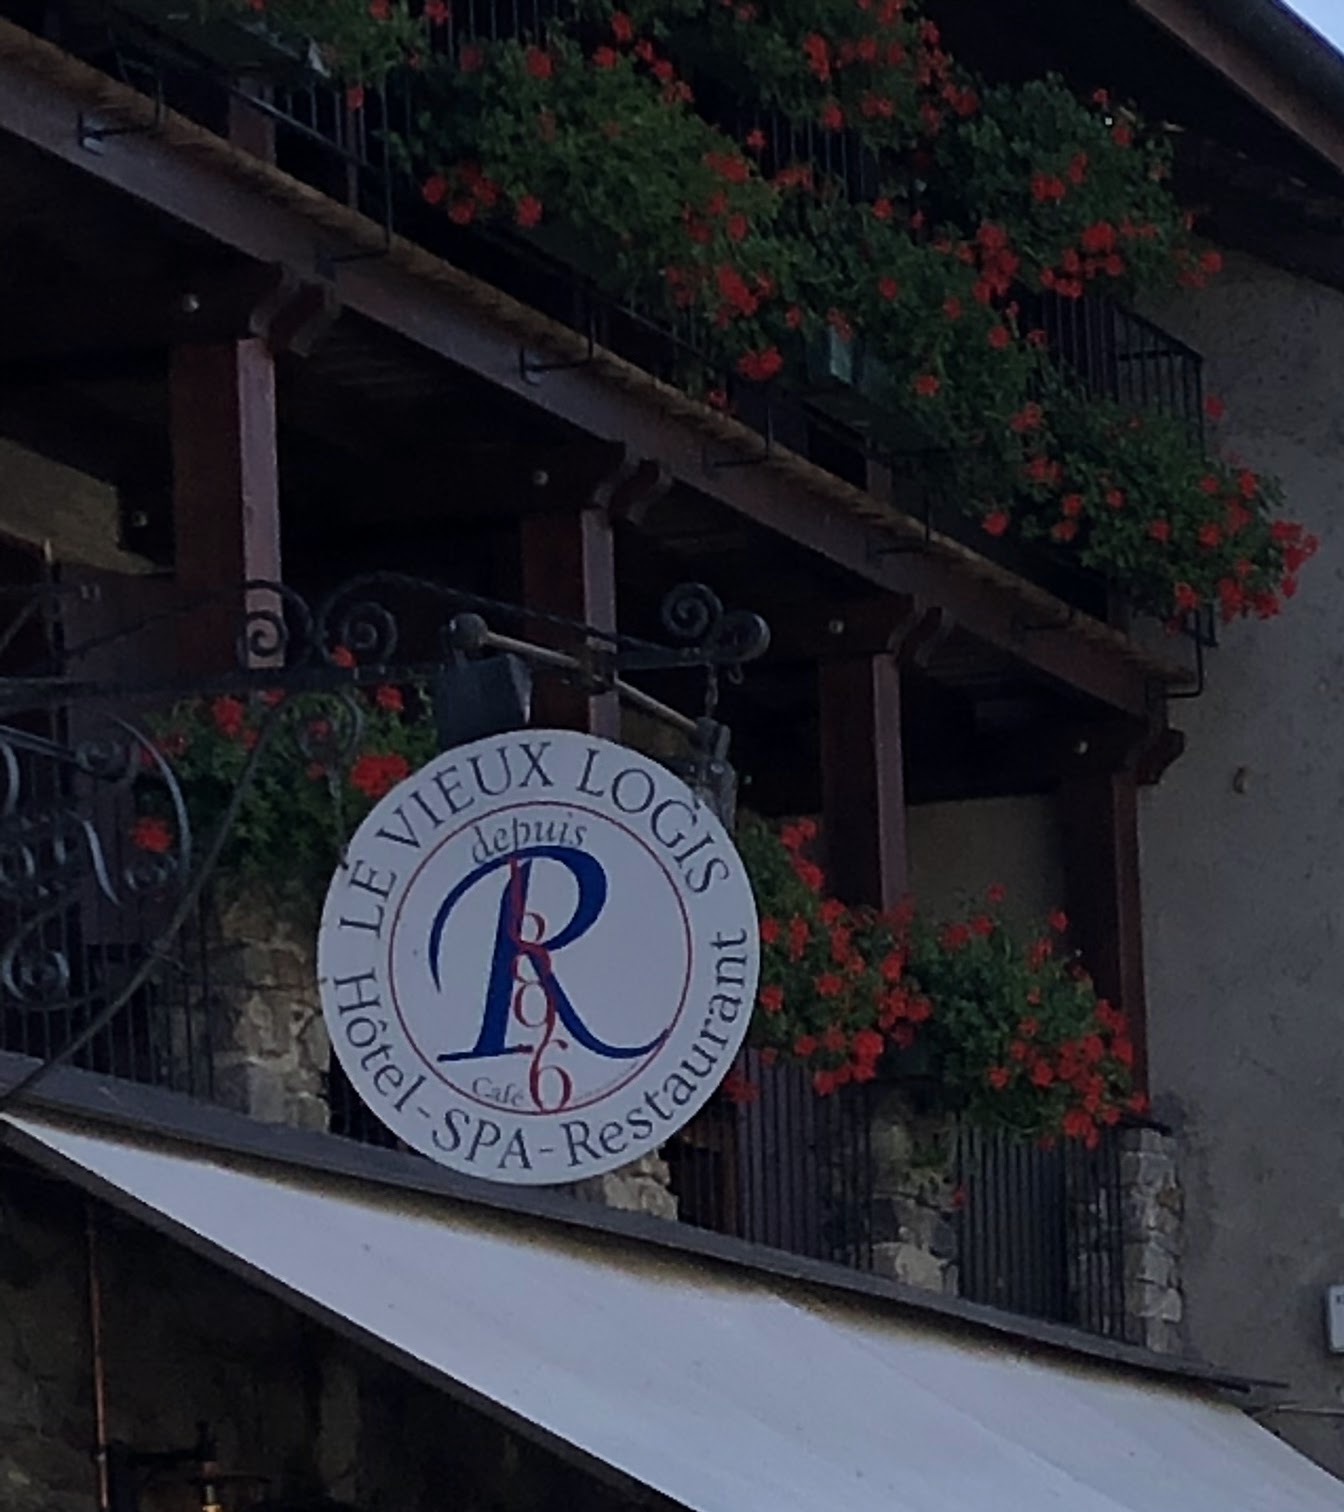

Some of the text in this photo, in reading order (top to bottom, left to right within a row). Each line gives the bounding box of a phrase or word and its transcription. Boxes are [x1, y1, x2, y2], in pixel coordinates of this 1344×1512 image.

[340, 741, 729, 938] LE VIEUX LOGIS
[471, 812, 587, 865] depuis
